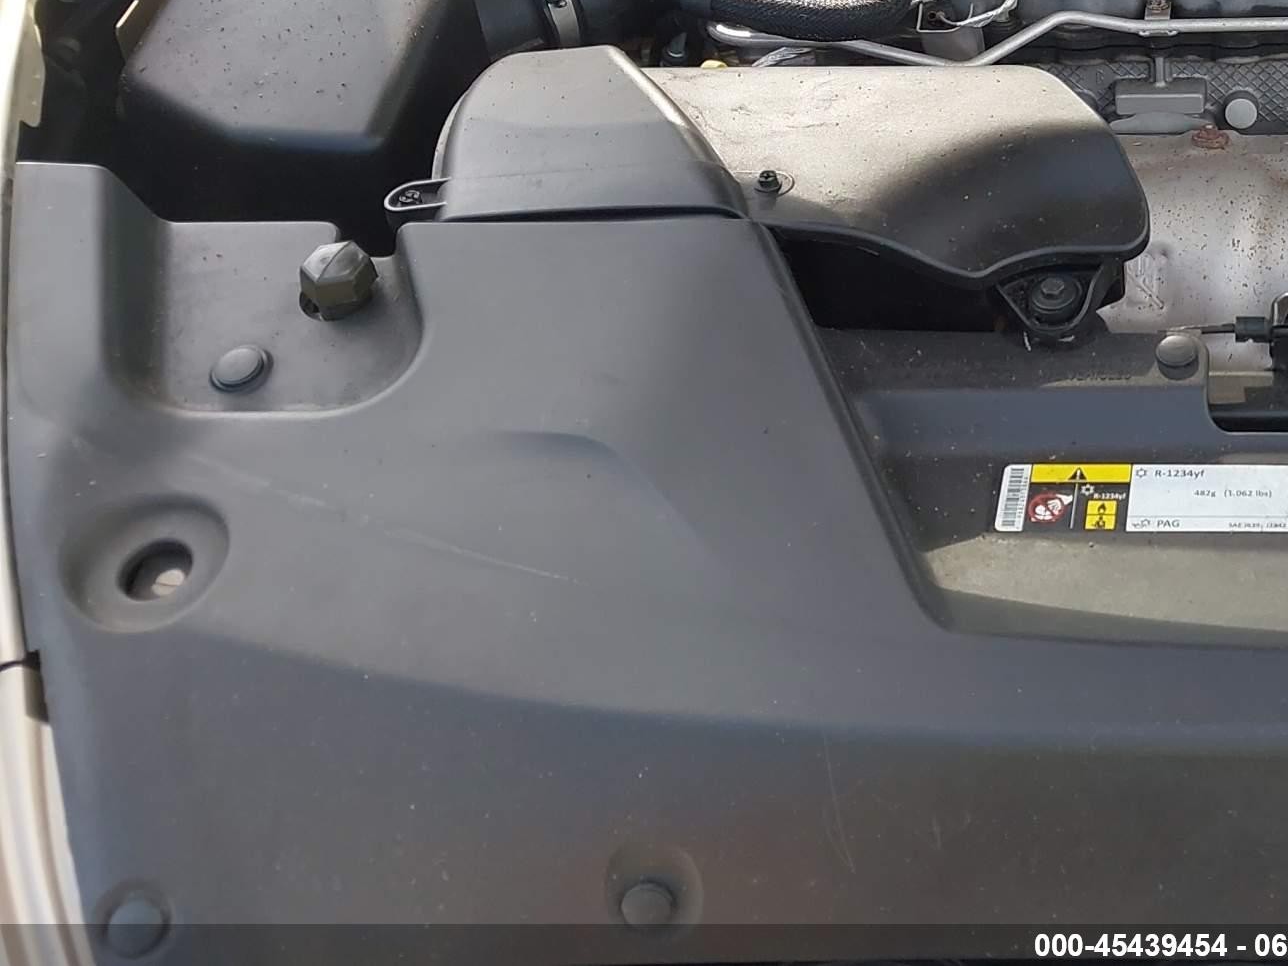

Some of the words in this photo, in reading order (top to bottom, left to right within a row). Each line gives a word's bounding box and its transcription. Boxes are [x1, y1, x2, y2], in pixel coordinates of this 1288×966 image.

[1154, 469, 1205, 479] R-1234yf
[1255, 489, 1273, 498] lbs)
[1156, 519, 1181, 529] PAG
